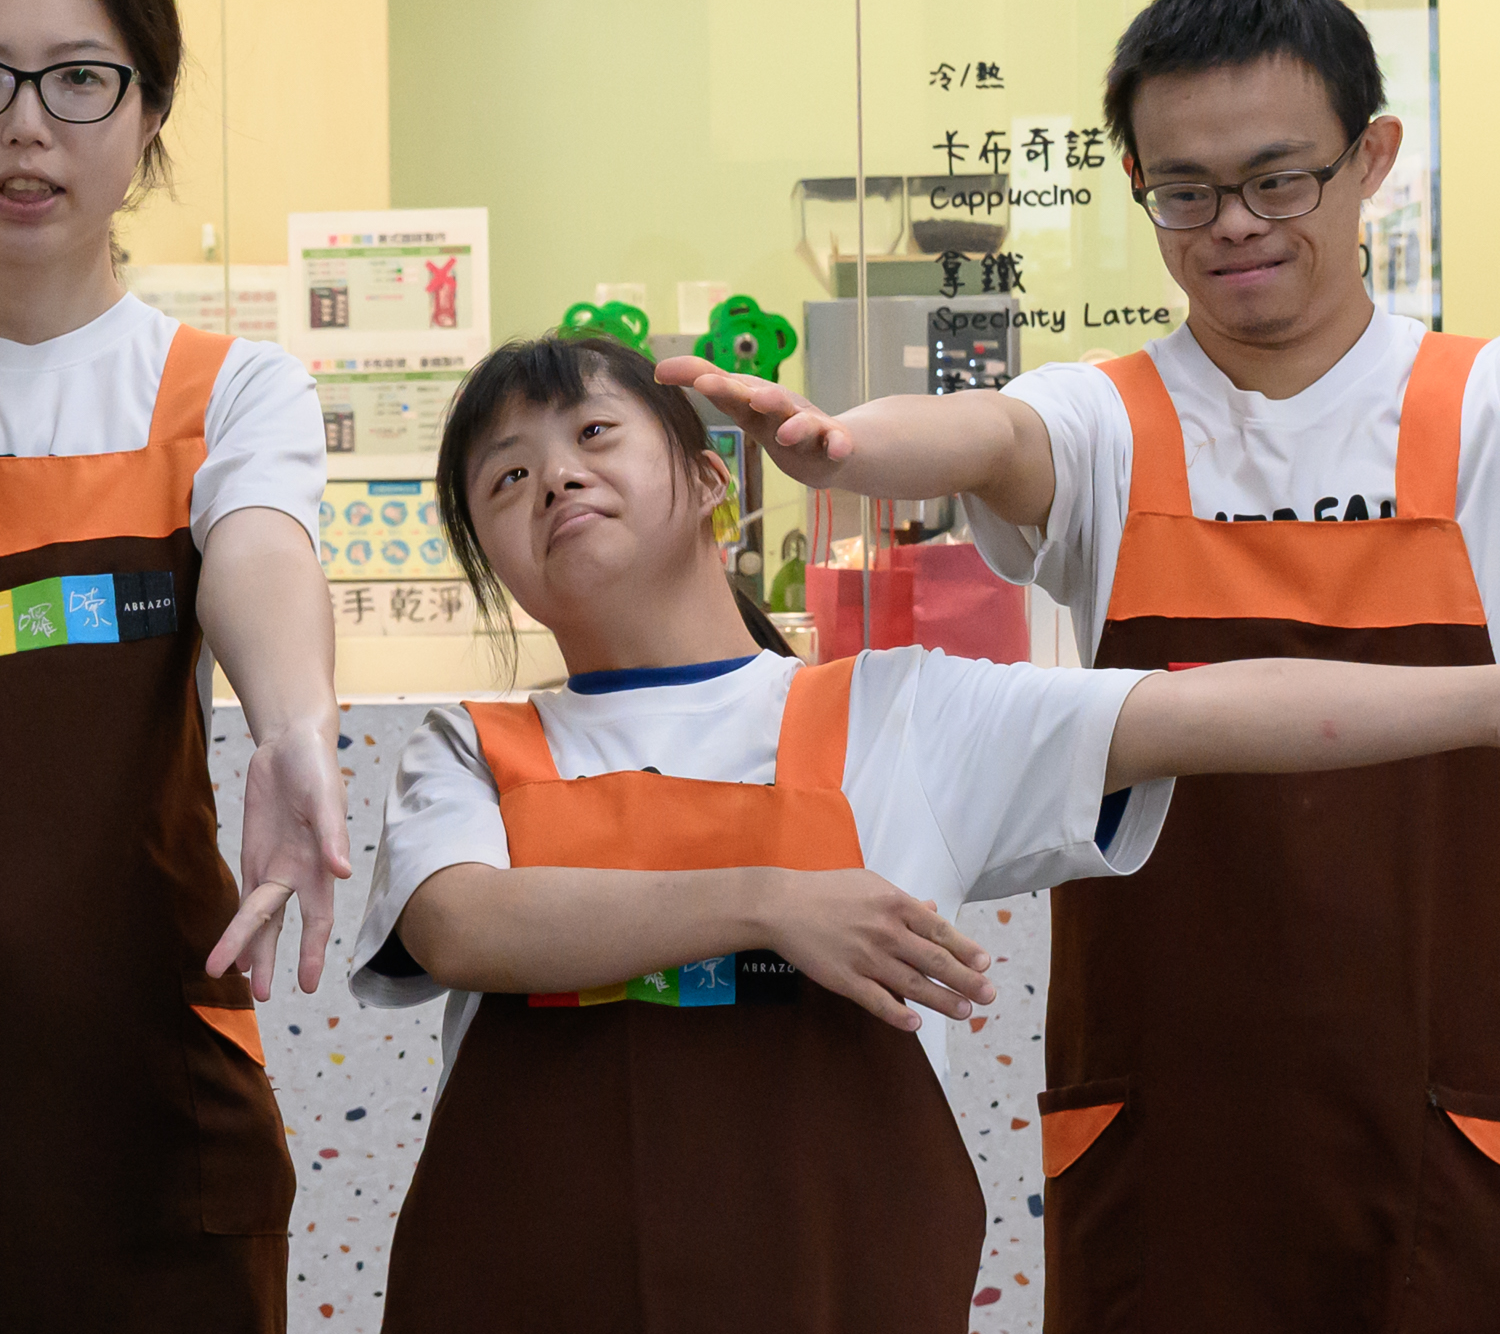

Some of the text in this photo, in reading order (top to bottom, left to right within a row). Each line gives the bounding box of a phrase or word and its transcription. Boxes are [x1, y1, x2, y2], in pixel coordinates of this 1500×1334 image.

[933, 127, 1107, 176] 卡布奇諾
[930, 185, 1092, 220] Cappuccino
[934, 250, 1027, 299] 拿鐵
[932, 302, 1171, 334] Specialty Latte
[123, 598, 171, 612] ABRAZO
[333, 585, 463, 624] 手乾淨
[742, 962, 796, 974] ABRAZO
